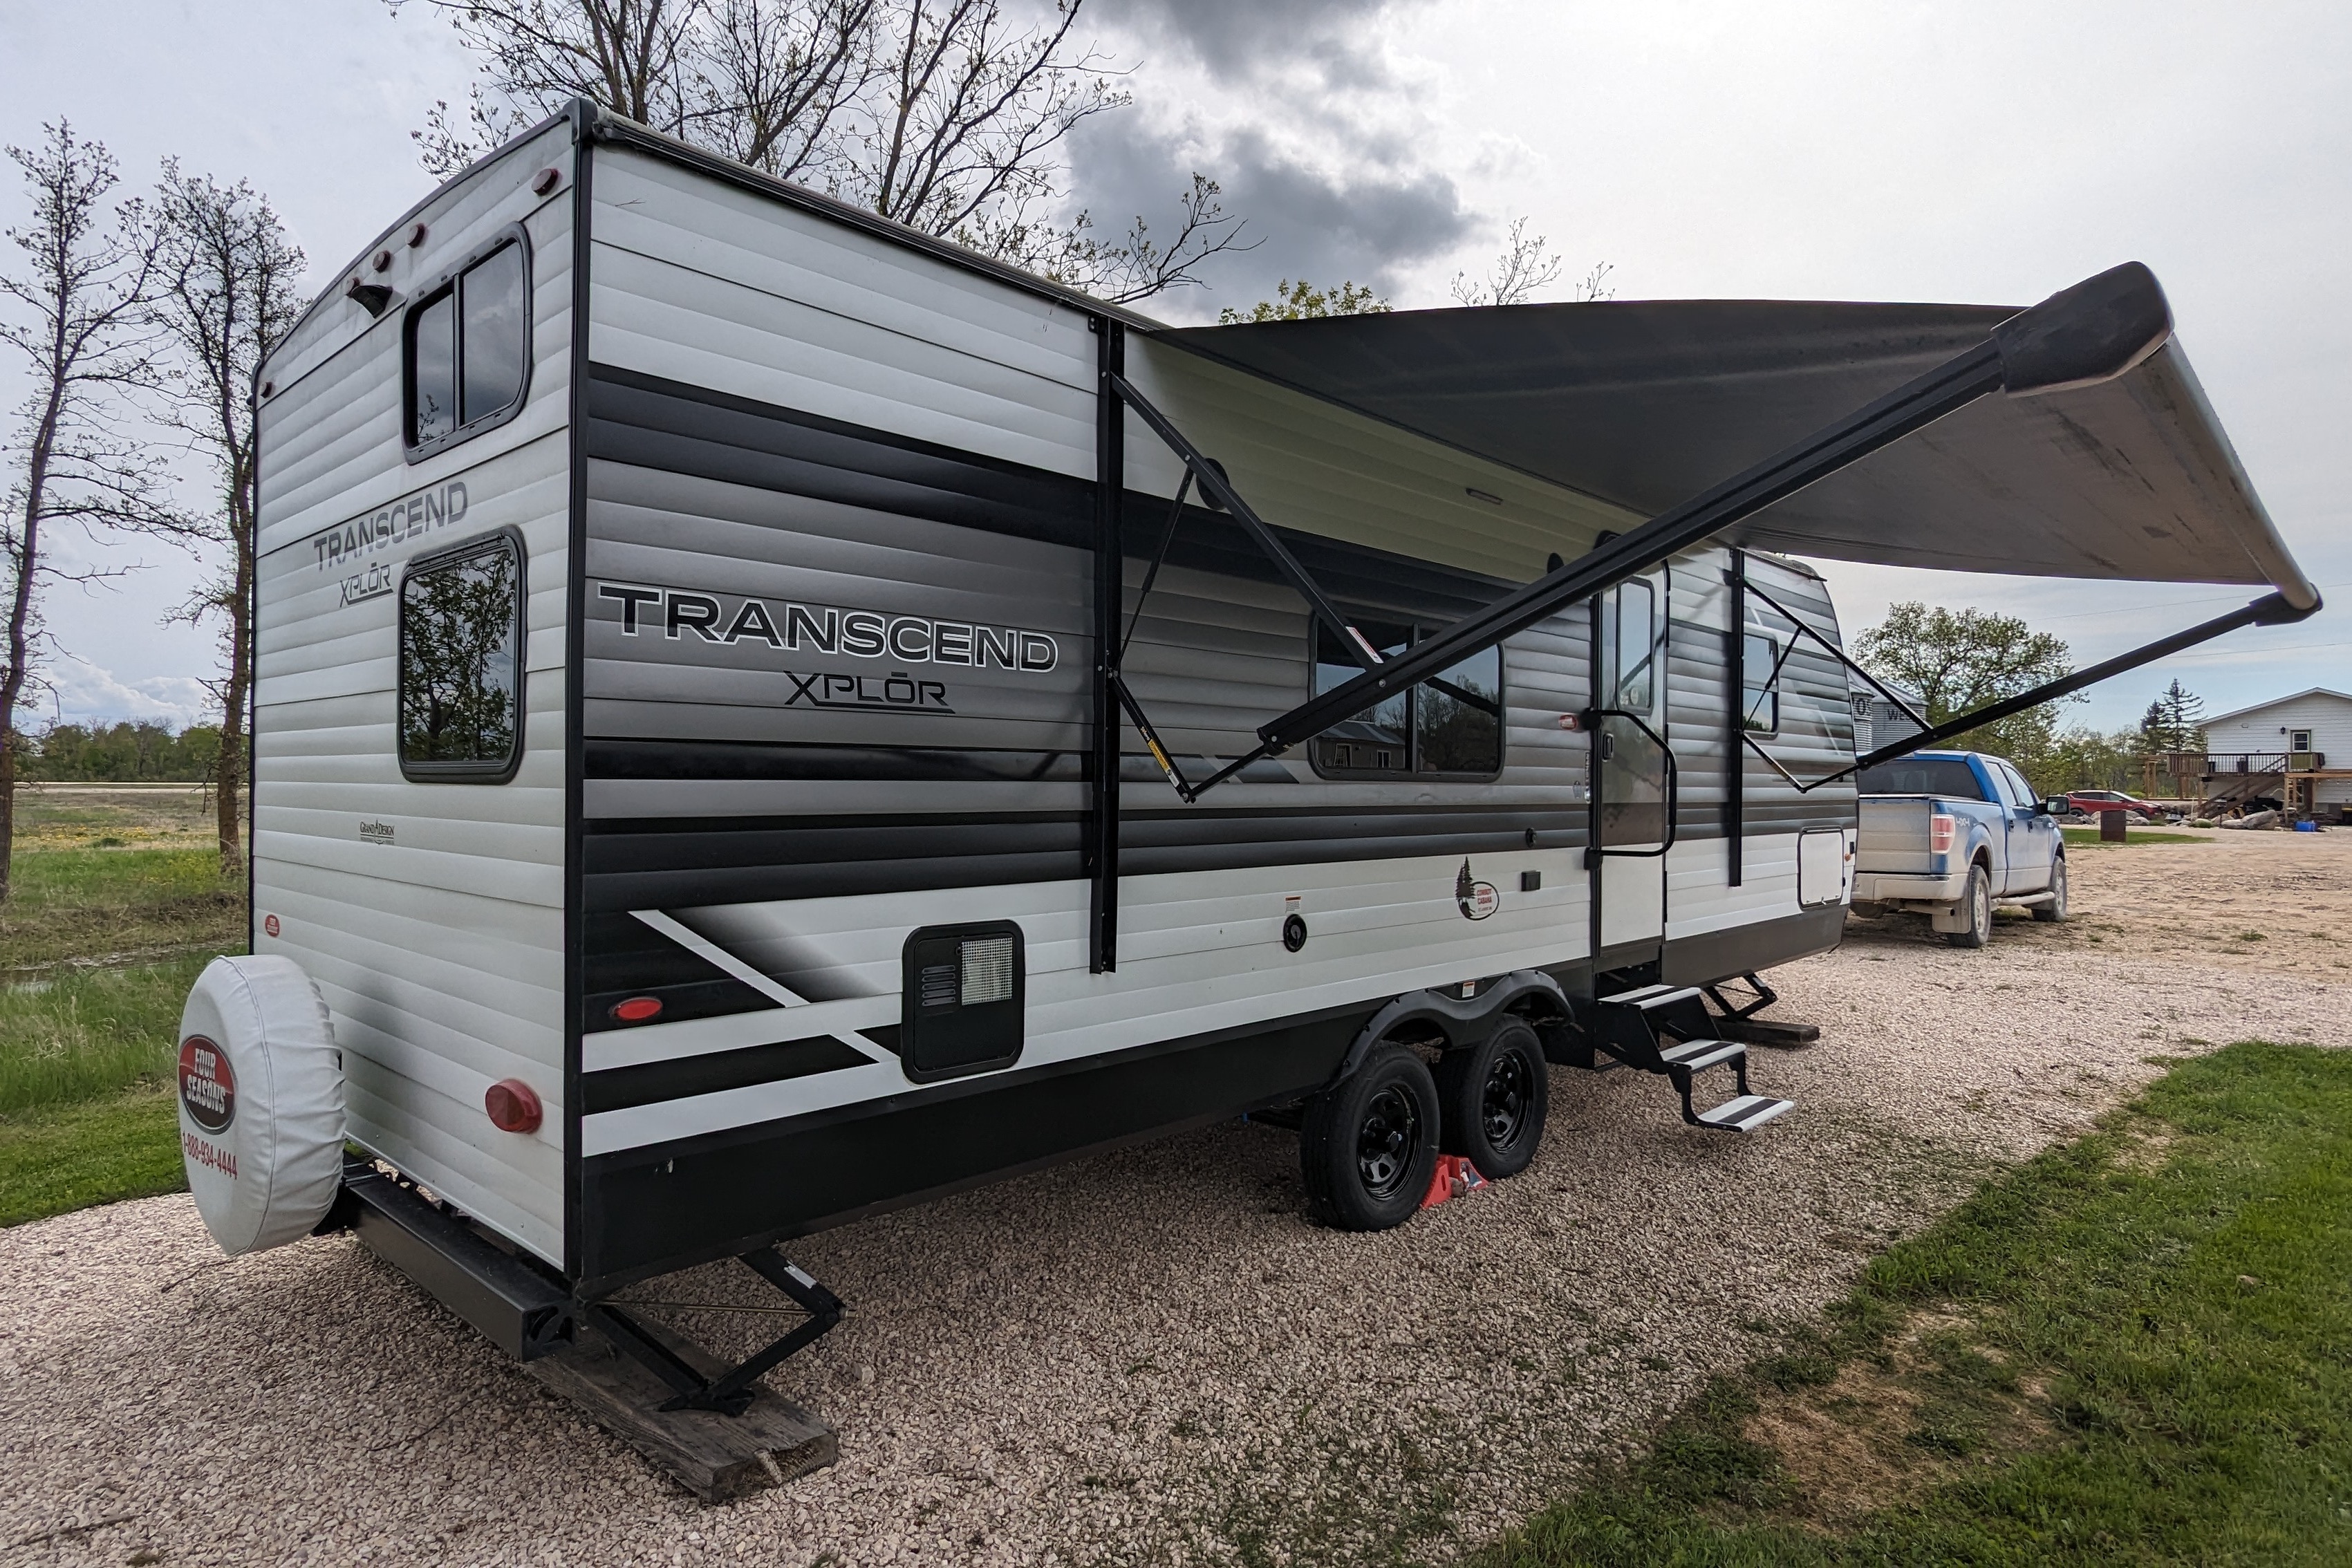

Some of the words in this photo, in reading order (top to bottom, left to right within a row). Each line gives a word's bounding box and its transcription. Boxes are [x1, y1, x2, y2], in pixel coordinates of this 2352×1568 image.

[313, 482, 468, 571] TRANSCEND
[597, 582, 1058, 673] TRANSCEND
[187, 1074, 225, 1114] SEASONS
[194, 1047, 216, 1079] FOUR
